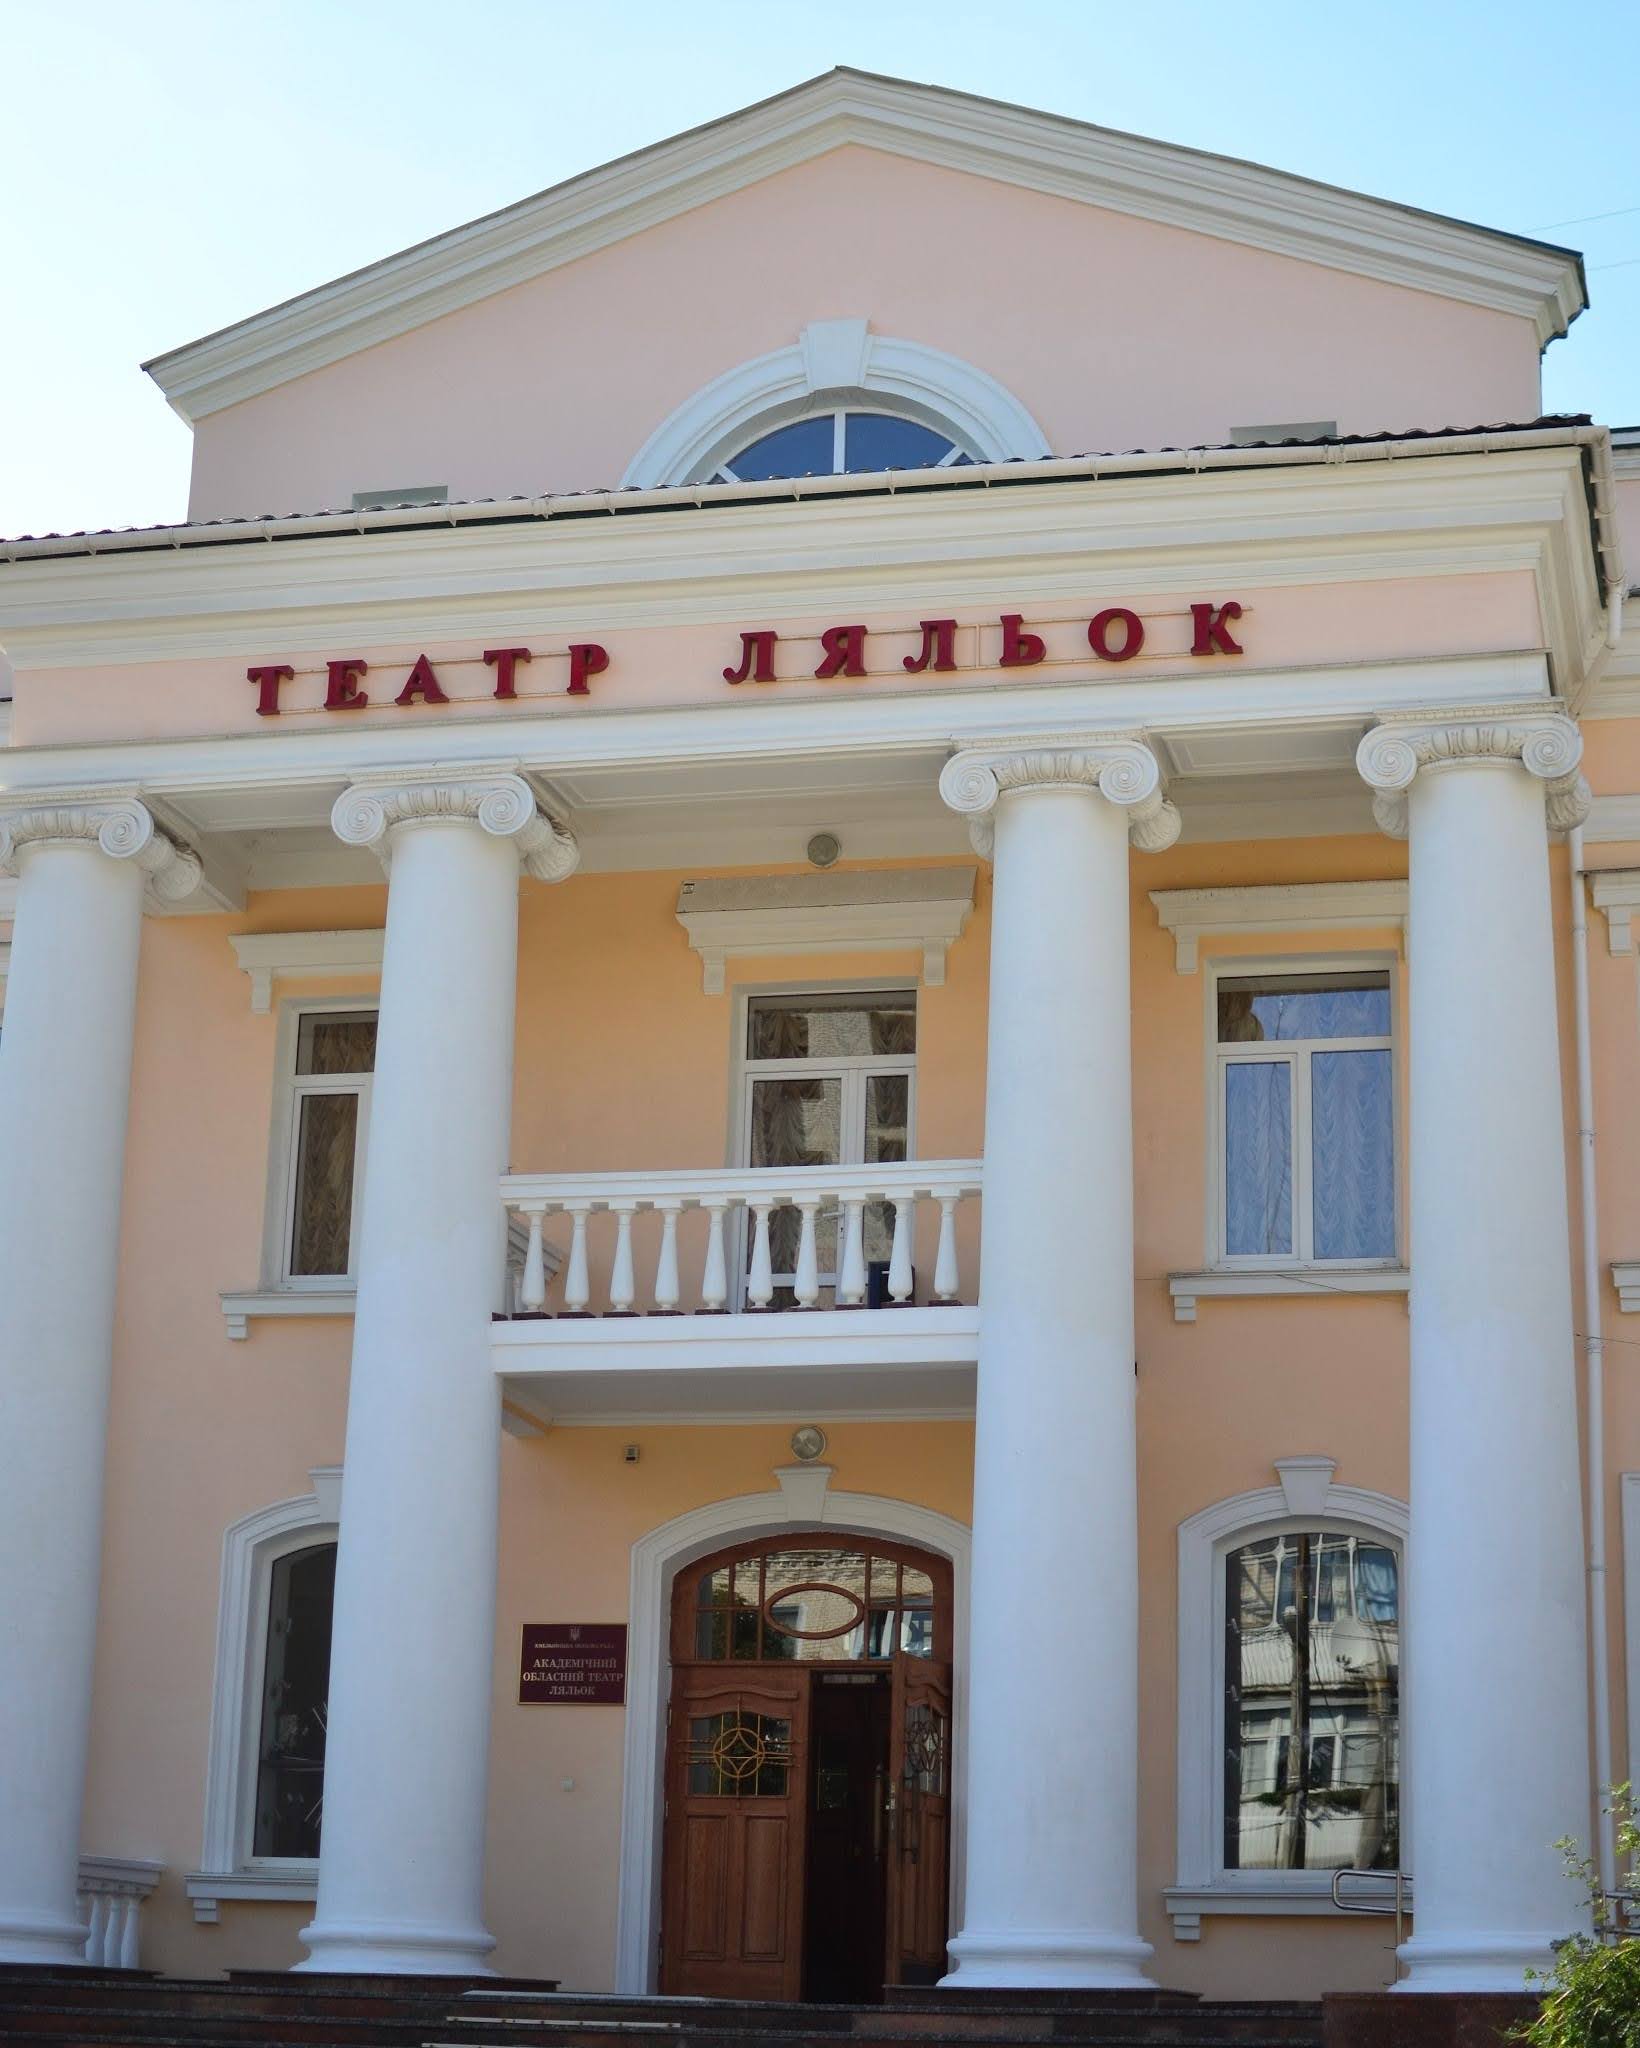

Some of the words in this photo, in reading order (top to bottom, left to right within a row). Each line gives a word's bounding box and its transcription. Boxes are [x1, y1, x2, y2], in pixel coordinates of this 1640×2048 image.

[247, 643, 609, 715] ТЕАТР
[723, 601, 1243, 684] ЛЯЛЬОК
[533, 1658, 617, 1669] АКАДЕМІЧНИЙ
[522, 1671, 584, 1682] ОБЛАСНИЙ
[588, 1672, 624, 1682] ТЕАТР
[549, 1686, 595, 1695] ЛЯЛЬОК
